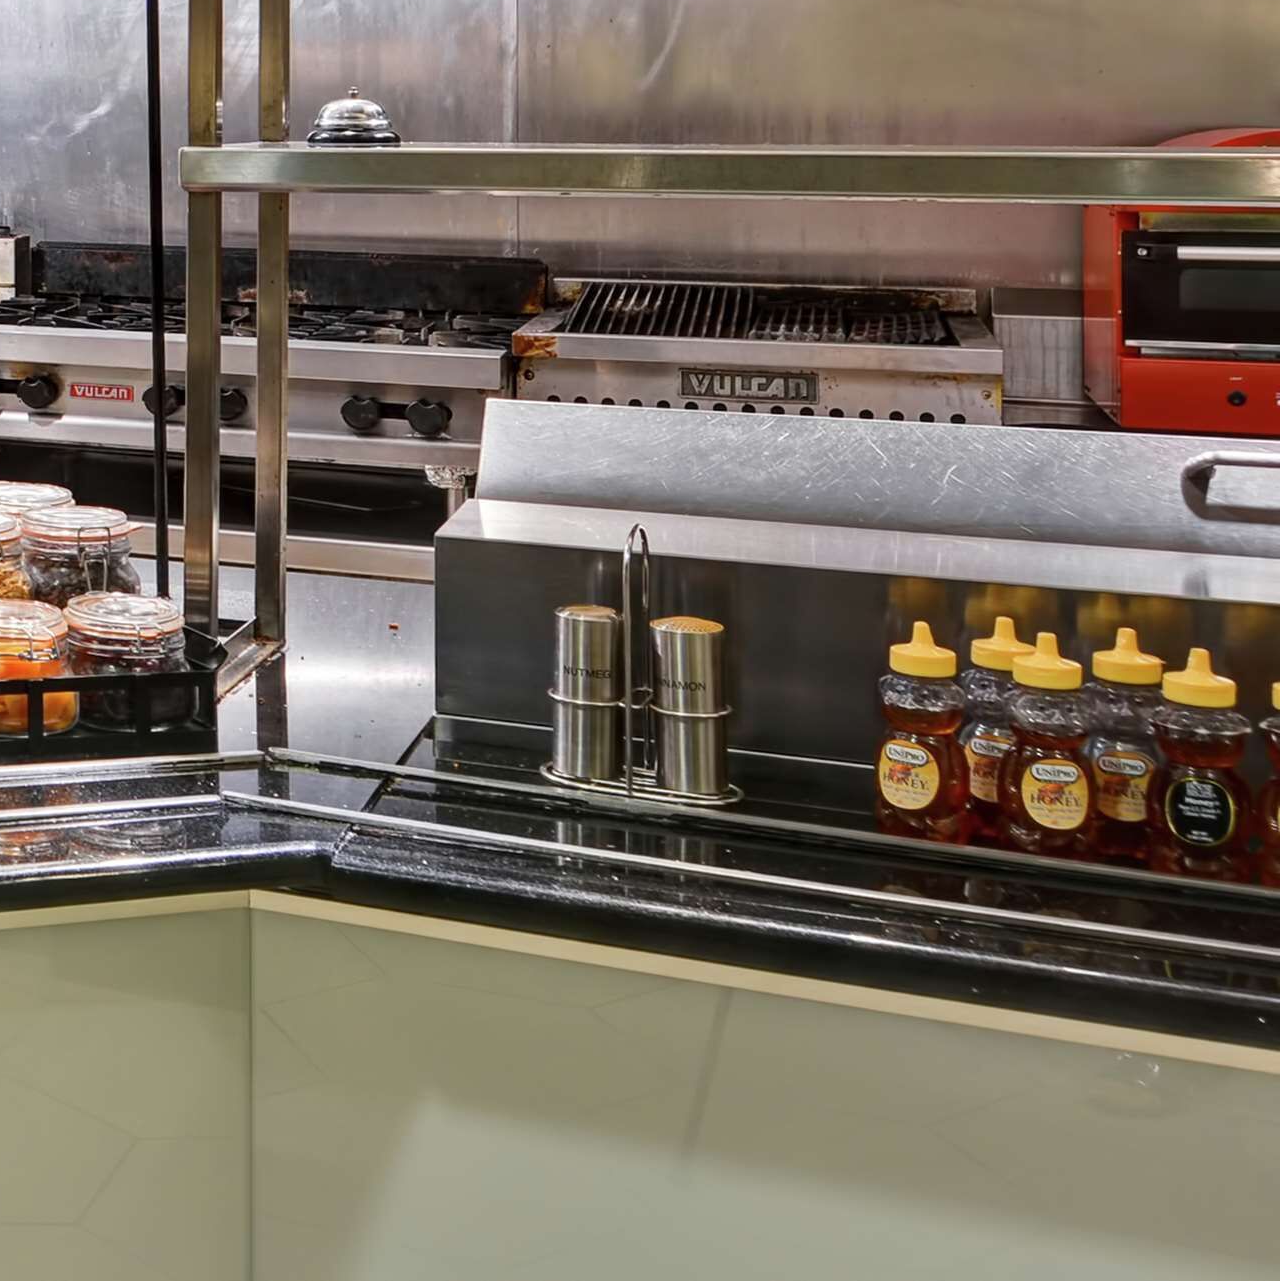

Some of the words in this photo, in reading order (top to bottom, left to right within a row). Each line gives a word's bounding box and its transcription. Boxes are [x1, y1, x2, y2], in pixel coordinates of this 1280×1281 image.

[73, 385, 128, 399] VULCAN
[688, 372, 808, 400] VULCAN
[563, 664, 611, 680] NUTMEG
